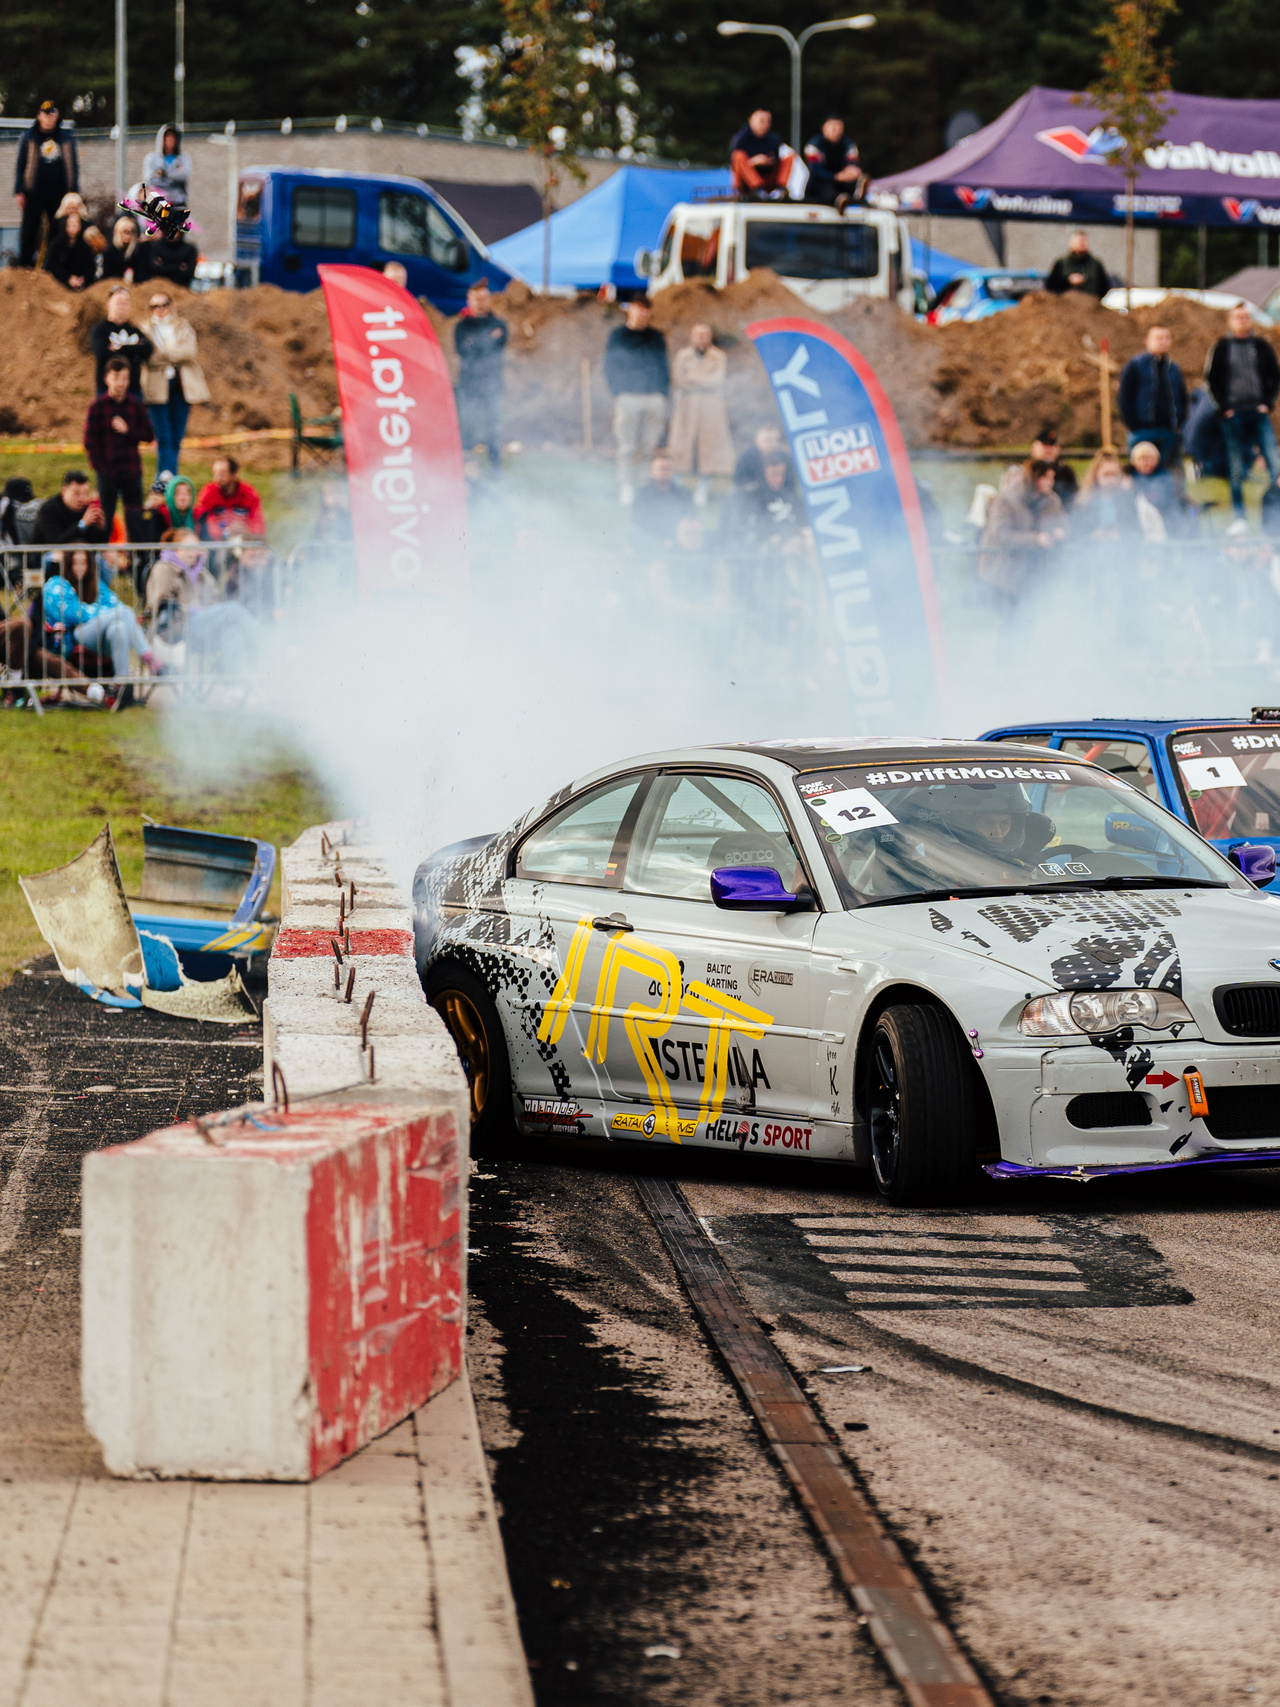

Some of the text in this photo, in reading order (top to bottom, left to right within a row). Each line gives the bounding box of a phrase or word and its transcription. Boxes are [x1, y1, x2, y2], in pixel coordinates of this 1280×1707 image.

[1206, 767, 1221, 779] 1
[837, 806, 876, 822] 12
[706, 962, 732, 975] BALTIC
[706, 977, 738, 990] KARTING
[829, 1065, 839, 1096] K
[552, 1124, 579, 1134] BODYPARTS
[763, 1123, 812, 1150] SPORT
